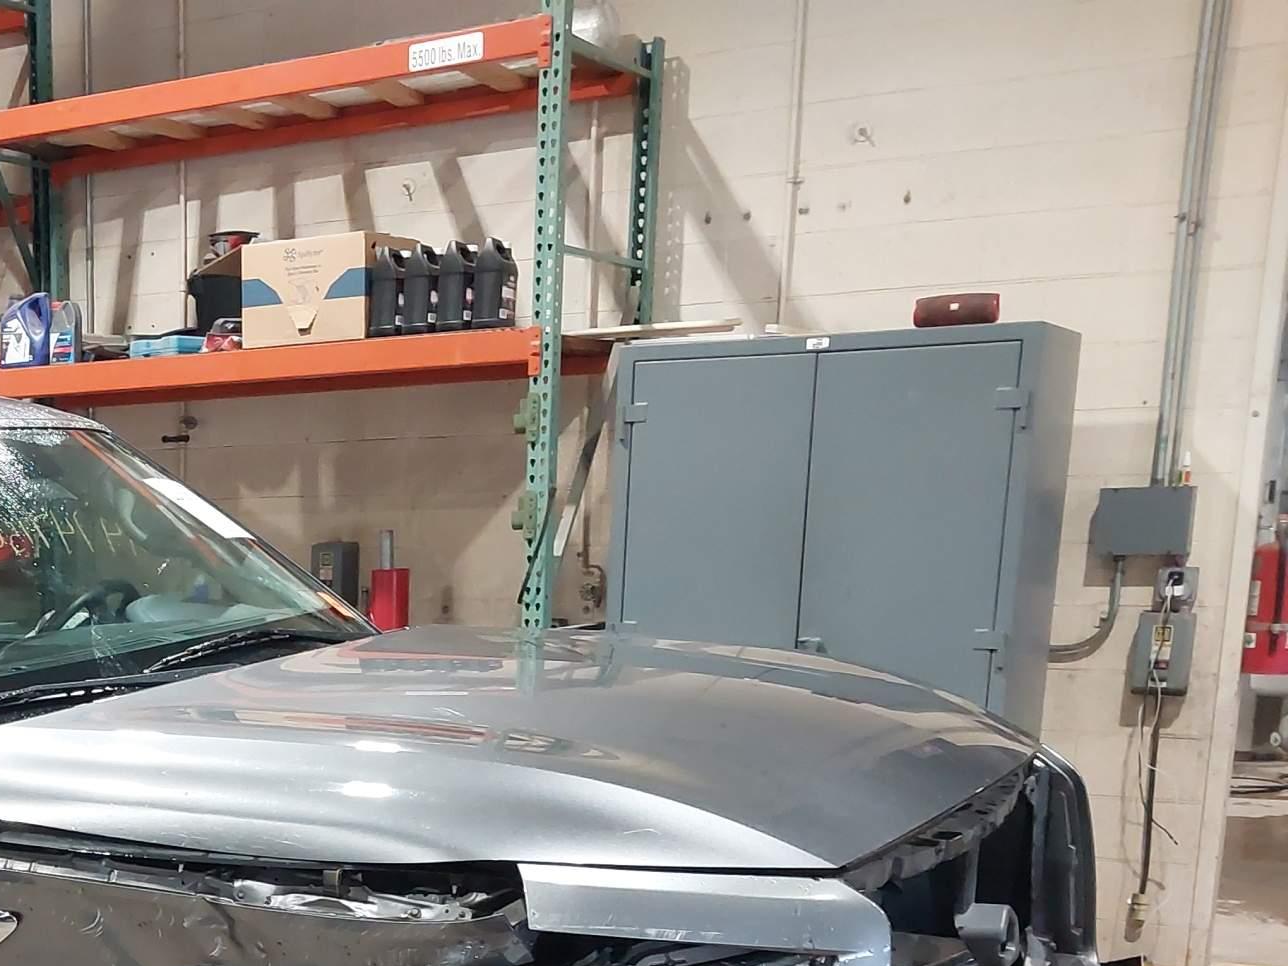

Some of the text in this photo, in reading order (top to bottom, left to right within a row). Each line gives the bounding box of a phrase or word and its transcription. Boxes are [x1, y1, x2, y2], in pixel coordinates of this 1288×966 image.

[412, 40, 481, 68] 5500 lbs. Max.
